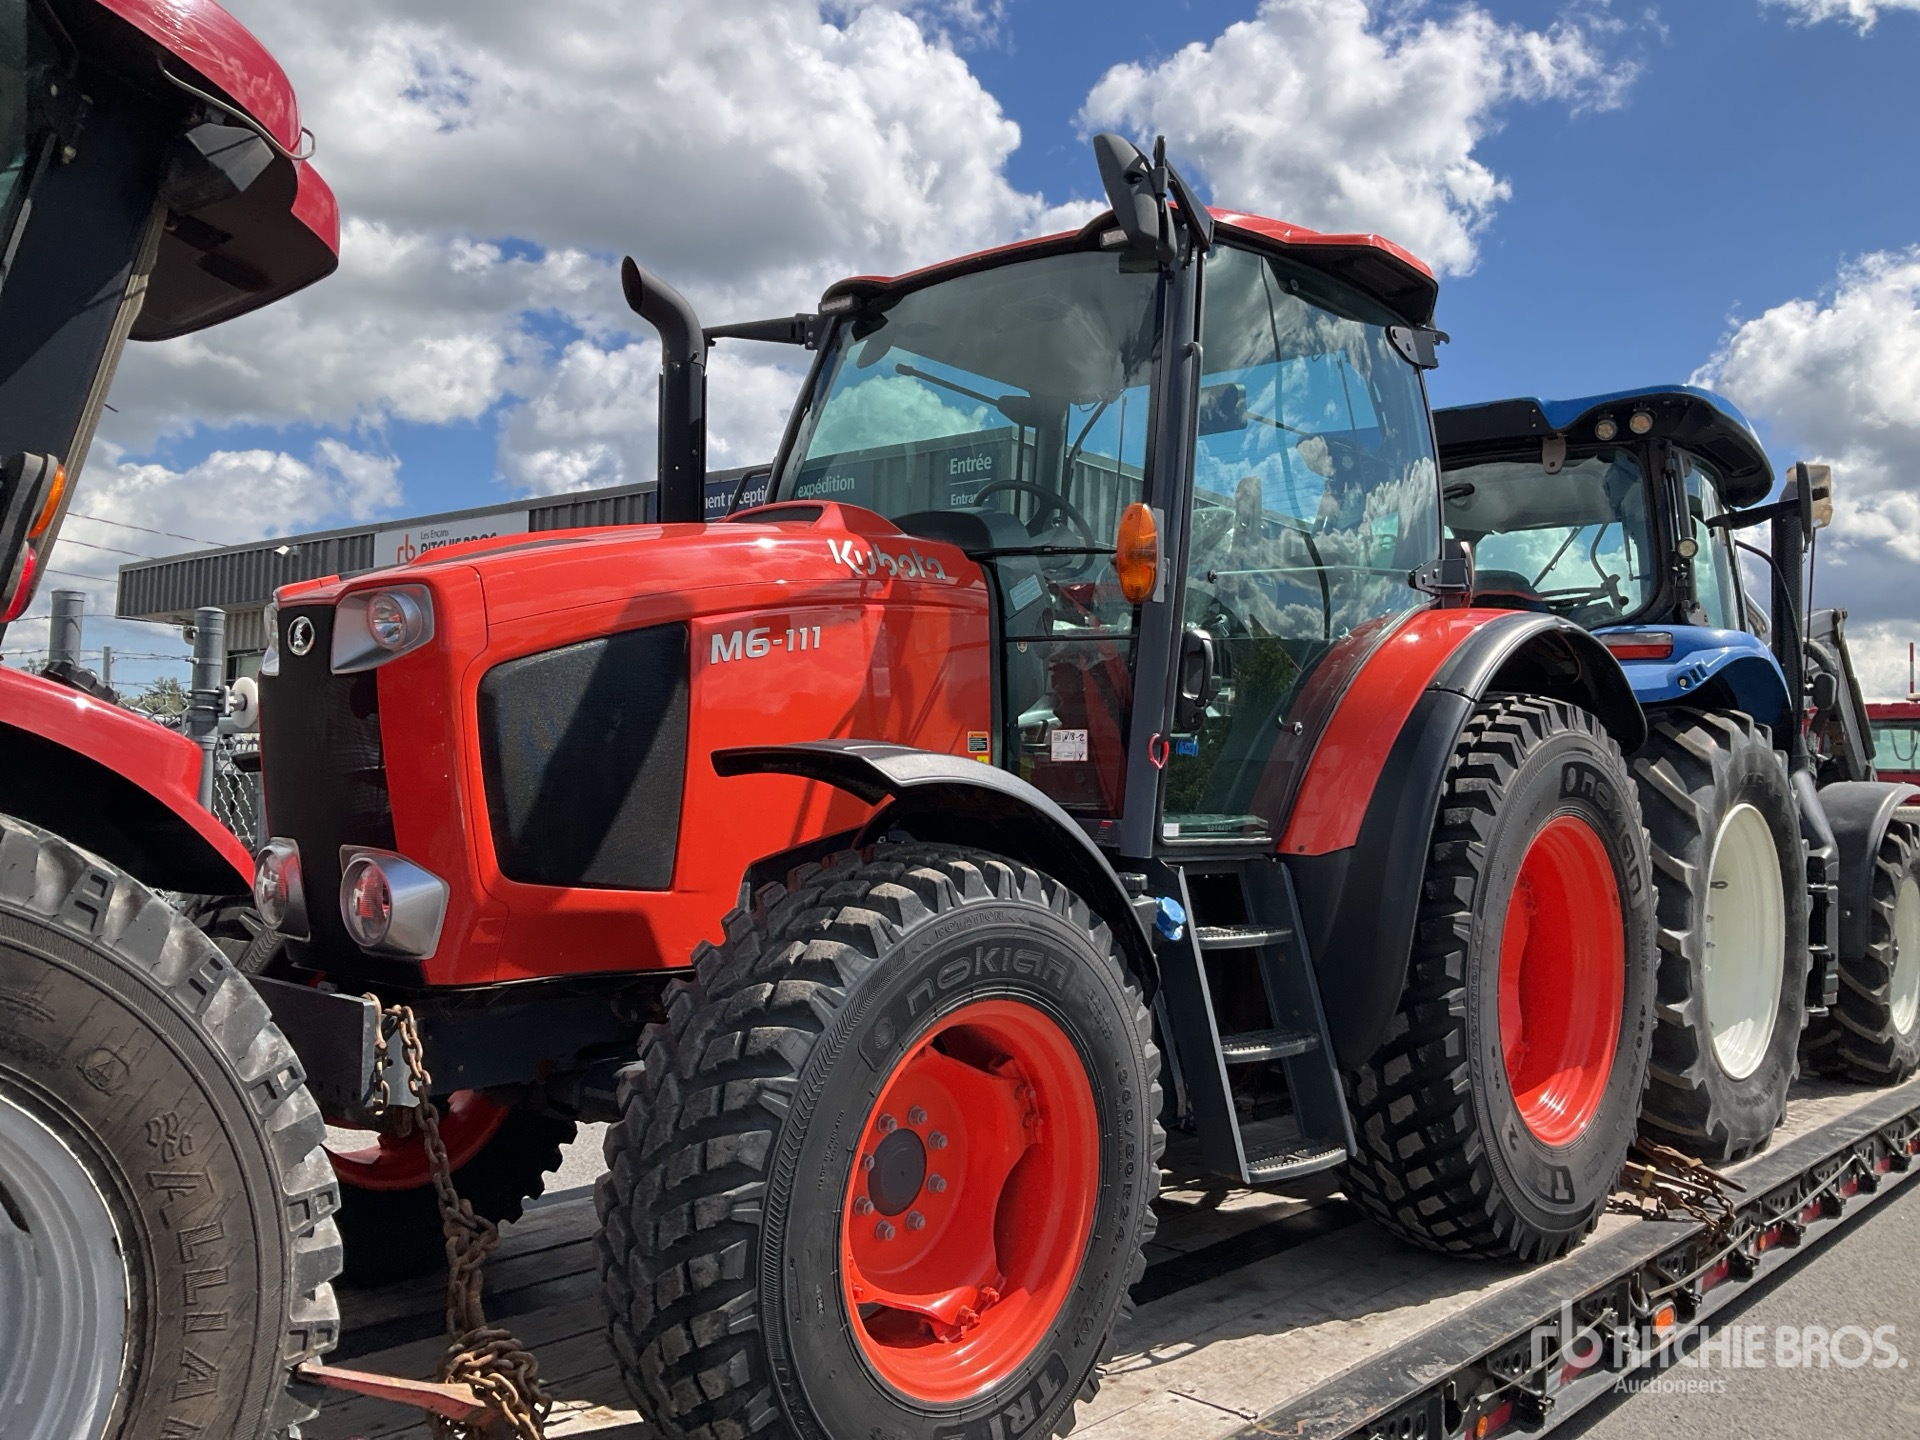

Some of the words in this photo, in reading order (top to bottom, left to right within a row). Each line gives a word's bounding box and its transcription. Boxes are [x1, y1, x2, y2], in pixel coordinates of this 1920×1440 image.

[950, 453, 992, 475] Entrée
[798, 475, 855, 500] expédition
[951, 493, 990, 506] Entra
[420, 531, 430, 540] Les
[827, 538, 947, 580] Kubota
[710, 626, 821, 665] M6-111
[935, 910, 1004, 939] ROTATION
